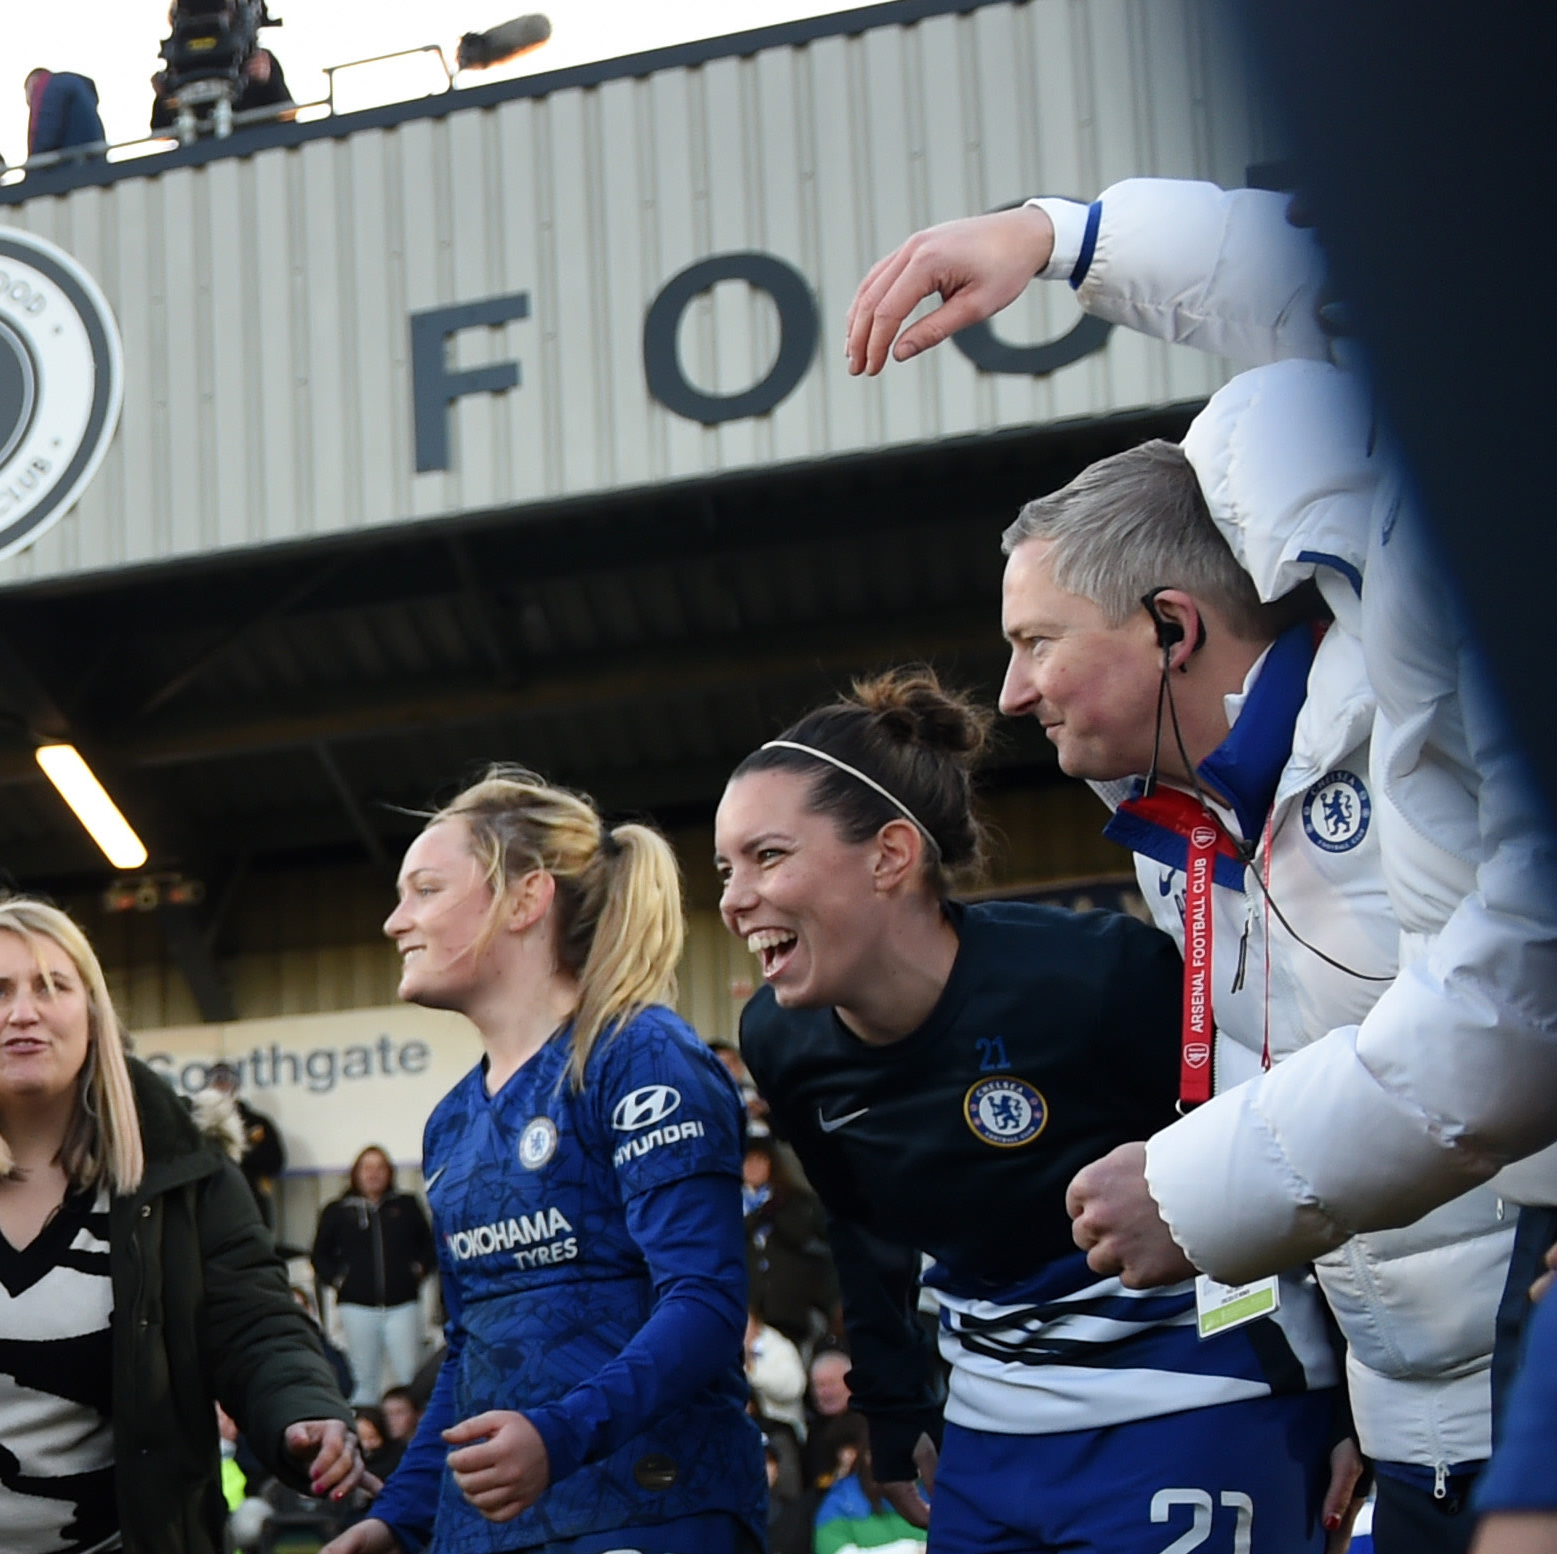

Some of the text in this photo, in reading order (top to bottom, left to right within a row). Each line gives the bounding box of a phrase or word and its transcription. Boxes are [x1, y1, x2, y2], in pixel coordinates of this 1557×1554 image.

[1309, 771, 1356, 796] CHELSEA
[1190, 857, 1208, 1034] ARSENAL FOOTBALL CLUB
[975, 1036, 1012, 1072] 21
[974, 1080, 1025, 1098] CHELSEA
[613, 1119, 705, 1169] HYUNDAI
[447, 1205, 574, 1262] YOKOHAMA
[512, 1236, 579, 1272] TYRES
